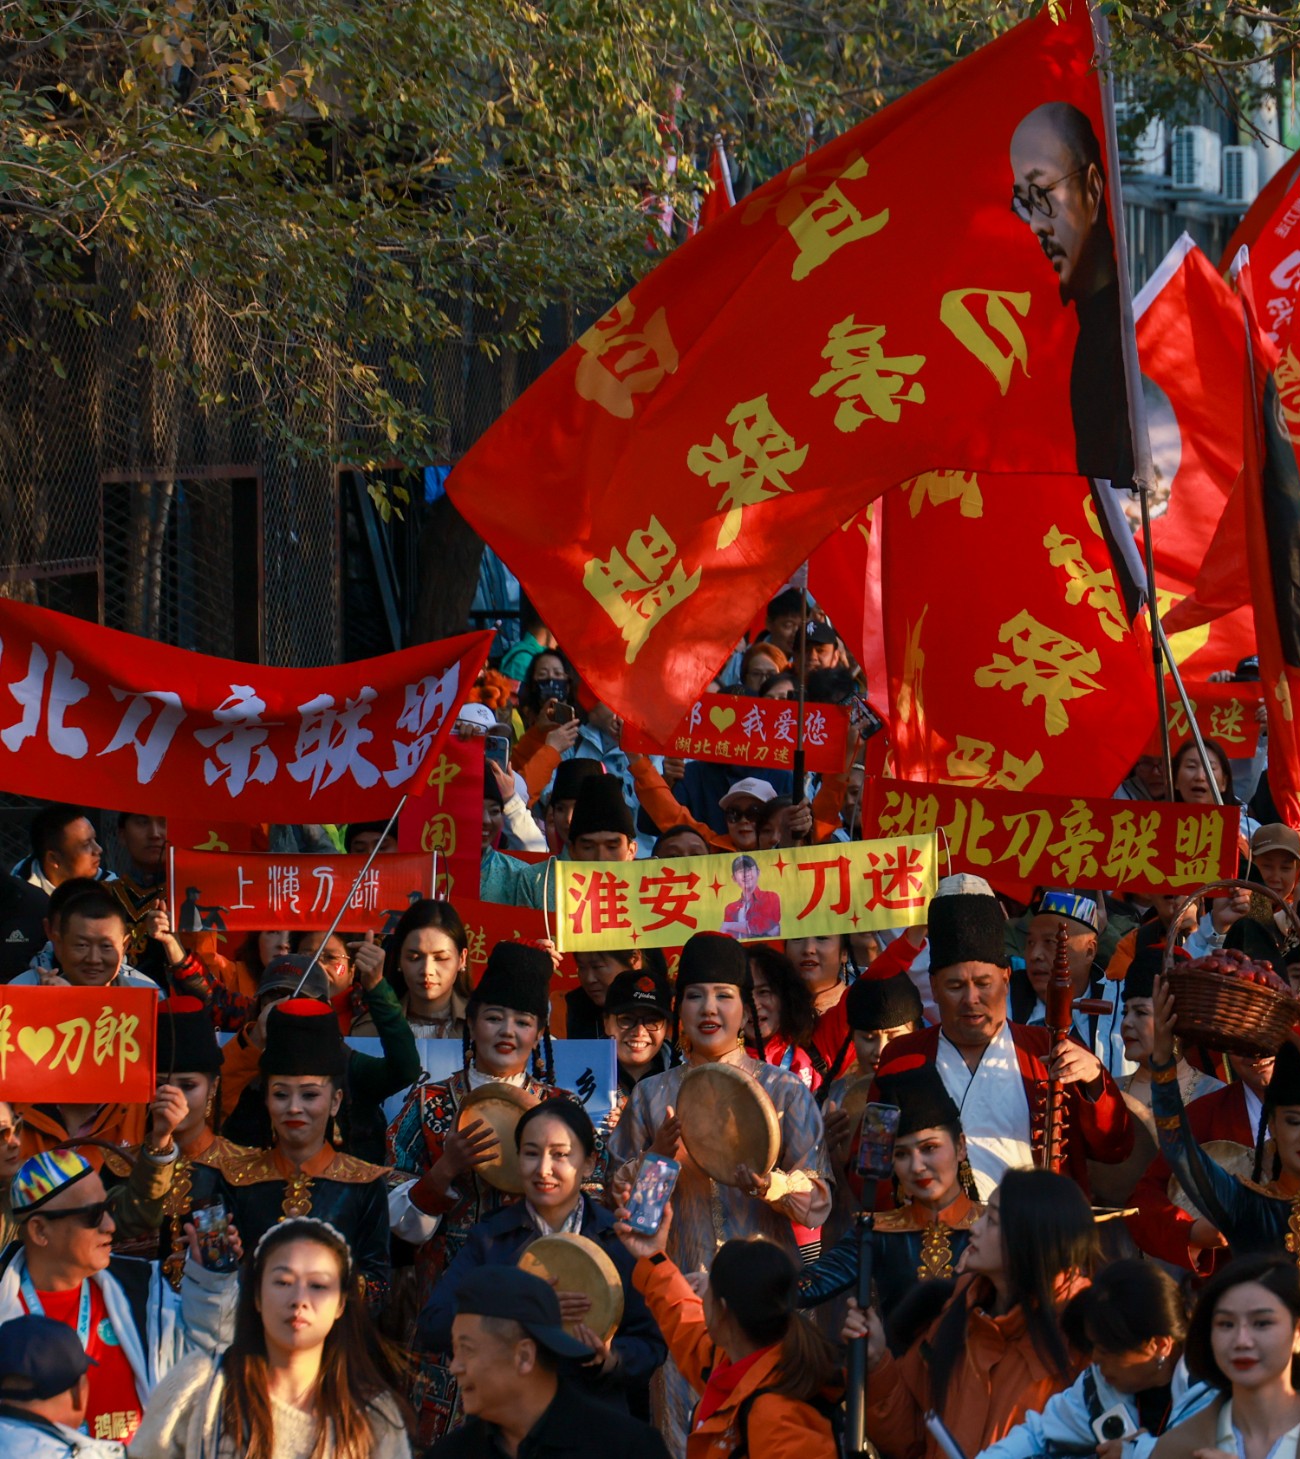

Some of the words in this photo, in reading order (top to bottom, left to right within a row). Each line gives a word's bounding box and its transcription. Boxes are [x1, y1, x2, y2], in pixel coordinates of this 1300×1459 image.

[0, 638, 461, 799] 北刀亲联盟
[675, 735, 791, 765] 湖北随州刀迷
[741, 703, 829, 747] 我爱您
[1168, 697, 1247, 744] 刀迷
[877, 790, 1225, 887] 湖北刀亲联盟
[568, 867, 702, 934] 淮安
[796, 845, 926, 921] 刀迷
[48, 1005, 141, 1084] 刀郎
